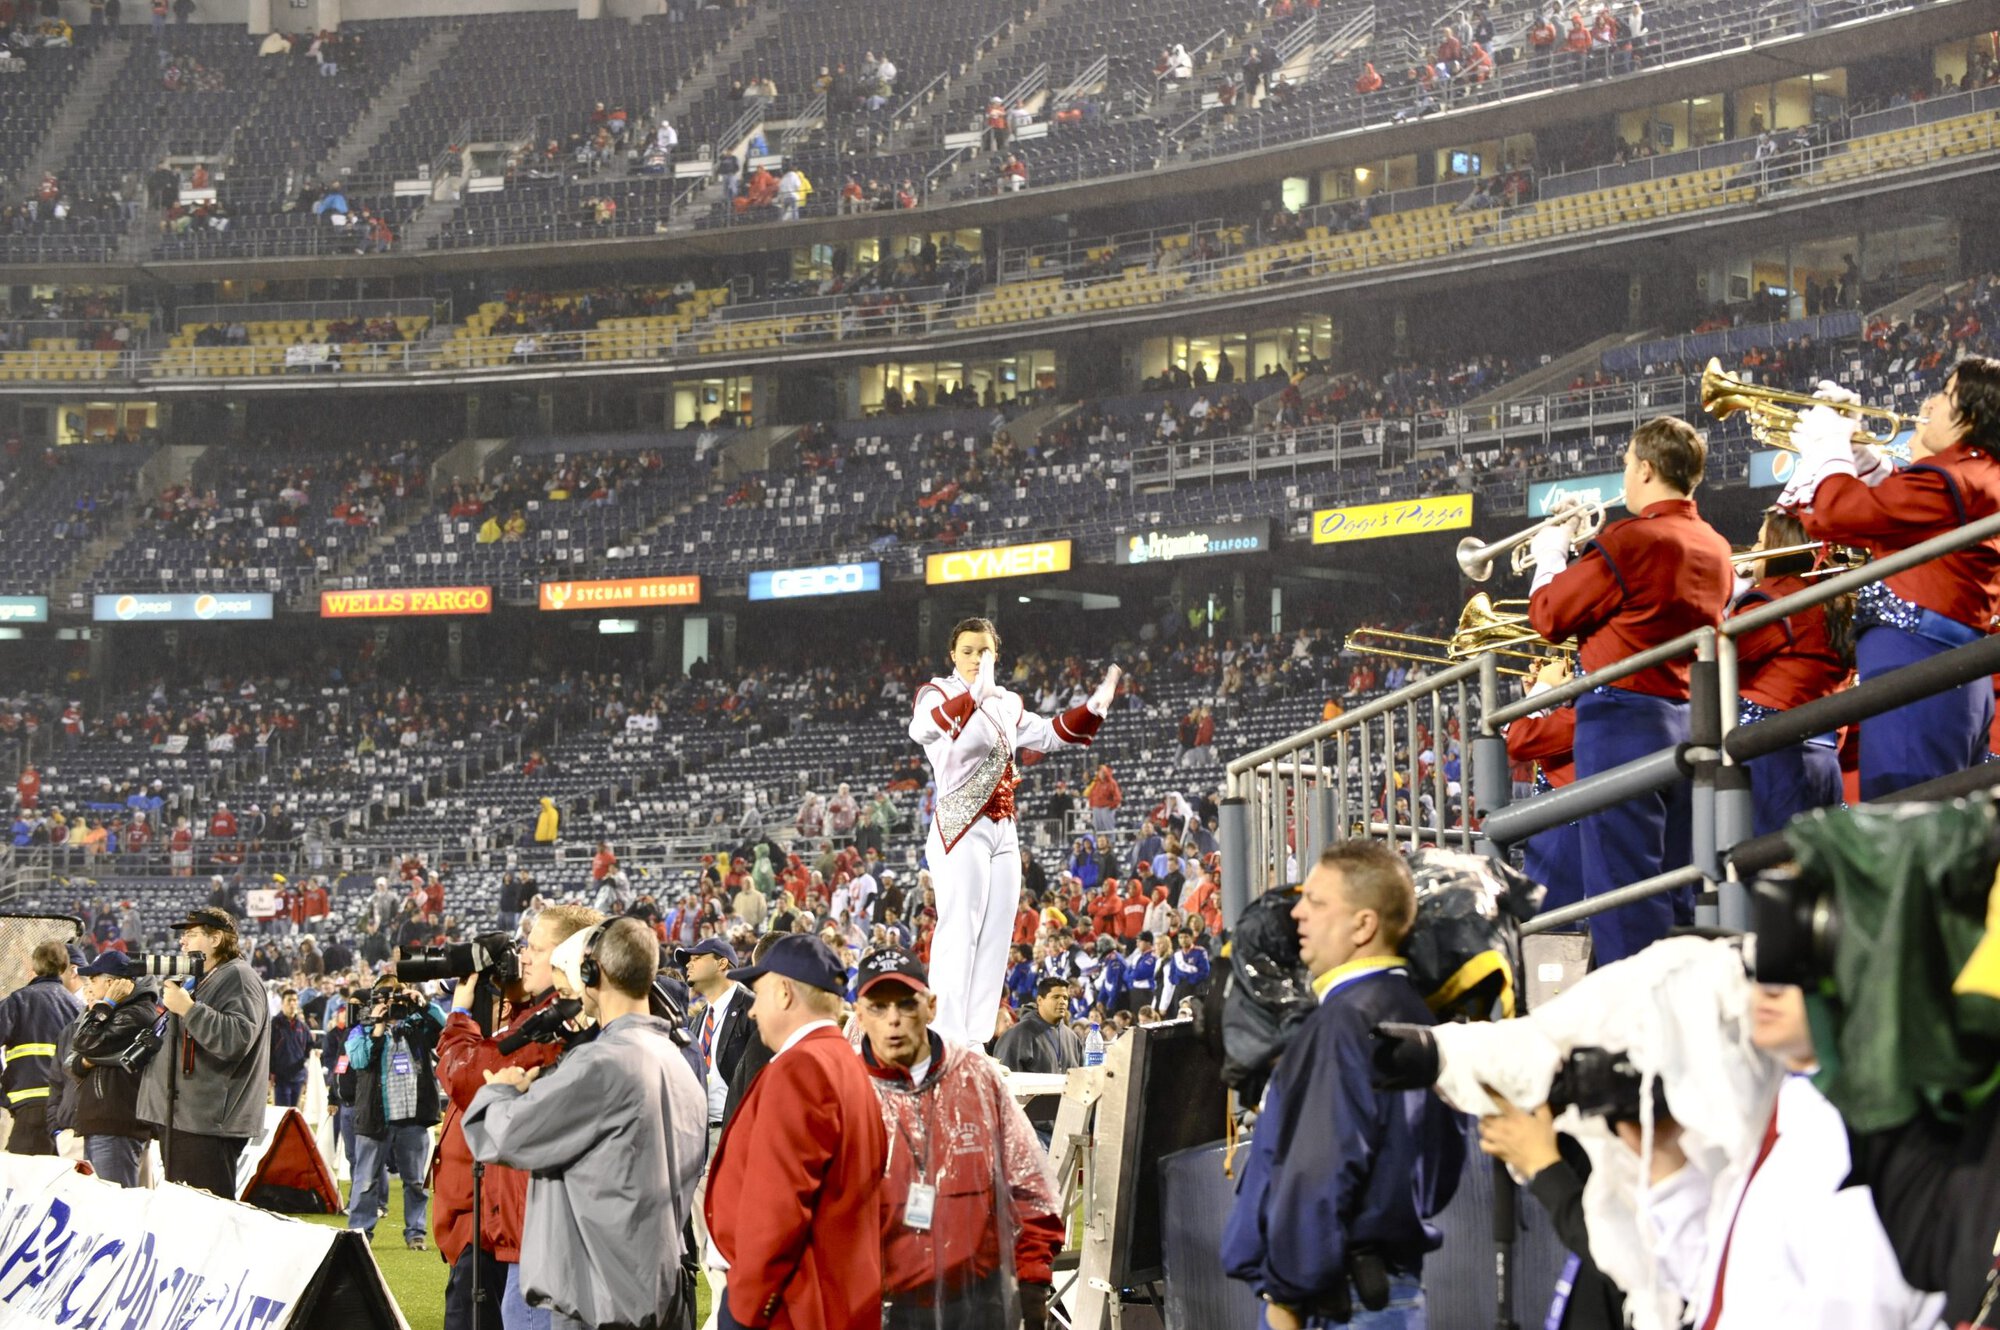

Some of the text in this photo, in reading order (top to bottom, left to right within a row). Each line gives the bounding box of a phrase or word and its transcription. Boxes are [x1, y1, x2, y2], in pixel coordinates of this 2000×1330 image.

[1208, 536, 1258, 551] SEAFOOD
[942, 544, 1055, 580] CYMER
[771, 564, 864, 597] GEICO
[576, 583, 695, 601] SYCUAN RESORT
[137, 600, 172, 614] pepsi
[217, 600, 252, 613] pepsi
[326, 590, 489, 613] WELLS FARGO
